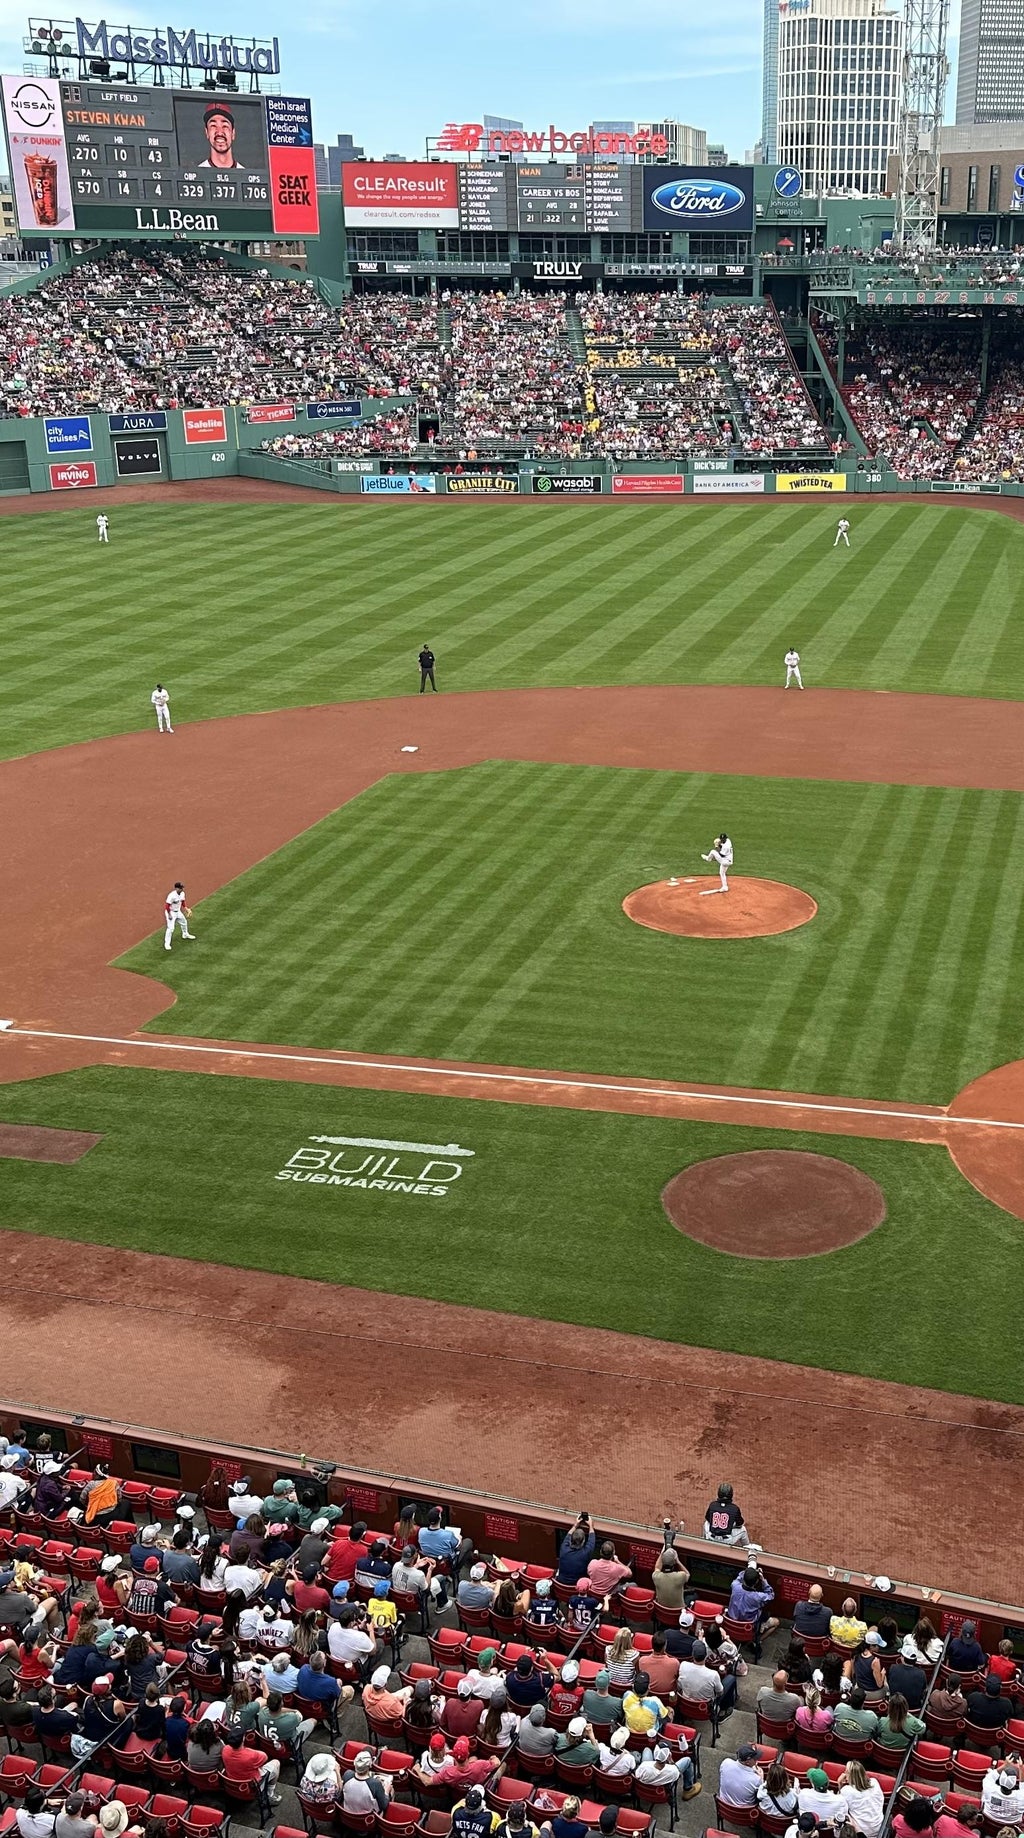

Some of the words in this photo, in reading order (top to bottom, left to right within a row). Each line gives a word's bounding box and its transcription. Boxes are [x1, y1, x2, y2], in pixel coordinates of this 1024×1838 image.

[76, 17, 280, 73] MassMutual
[101, 93, 118, 102] LEFT
[120, 94, 138, 103] FIELD
[11, 101, 56, 110] NISSAN
[269, 100, 286, 111] Beth
[287, 102, 307, 113] Israel
[67, 111, 111, 125] STEVEN
[114, 114, 145, 127] KWAN
[270, 113, 308, 123] Deaconess
[271, 123, 299, 133] Medical
[77, 134, 90, 143] AVG
[114, 136, 124, 144] HR
[148, 138, 159, 146] RBI
[271, 134, 296, 144] Center
[490, 130, 545, 152] new
[550, 125, 668, 155] balance
[72, 148, 98, 161] .270
[115, 150, 127, 162] 10
[148, 151, 162, 163] 43
[82, 169, 92, 177] PA
[118, 171, 127, 179] SB
[152, 172, 162, 180] CS
[184, 173, 197, 181] OBP
[217, 174, 229, 182] SLG
[279, 175, 309, 190] SEAT
[354, 177, 446, 192] CLEAResult
[77, 182, 100, 194] 570
[118, 183, 130, 195] 14
[155, 184, 162, 196] 4
[180, 186, 204, 197] .329
[213, 187, 235, 198] .377
[245, 188, 267, 199] .706
[523, 189, 551, 197] CAREER
[554, 189, 564, 197] VS
[566, 189, 580, 197] BOS
[279, 191, 312, 206] GEEK
[670, 184, 727, 212] Ford
[771, 200, 798, 208] Johnson
[775, 208, 803, 216] Controls
[136, 208, 219, 231] L.L.Bean
[543, 215, 560, 223] .322
[571, 215, 577, 223] 4
[533, 262, 583, 275] TRULY
[267, 408, 294, 420] TICKET
[187, 419, 223, 429] Safelite
[48, 427, 64, 436] city
[49, 434, 78, 443] cruises
[119, 453, 158, 461] VOLVO
[211, 453, 225, 462] 420
[338, 462, 360, 472] DICK'S
[694, 462, 715, 471] DICK'S
[57, 470, 89, 481] IRVING
[866, 474, 882, 482] 380
[366, 478, 404, 491] jetBlue
[449, 477, 493, 491] GRANITE
[495, 477, 517, 490] CITY
[553, 477, 594, 488] wasabi
[789, 479, 819, 490] TWISTED
[820, 479, 833, 489] TEA
[285, 1147, 463, 1183] BUILD
[274, 1170, 449, 1197] SUBMARINES
[264, 1725, 280, 1740] 16
